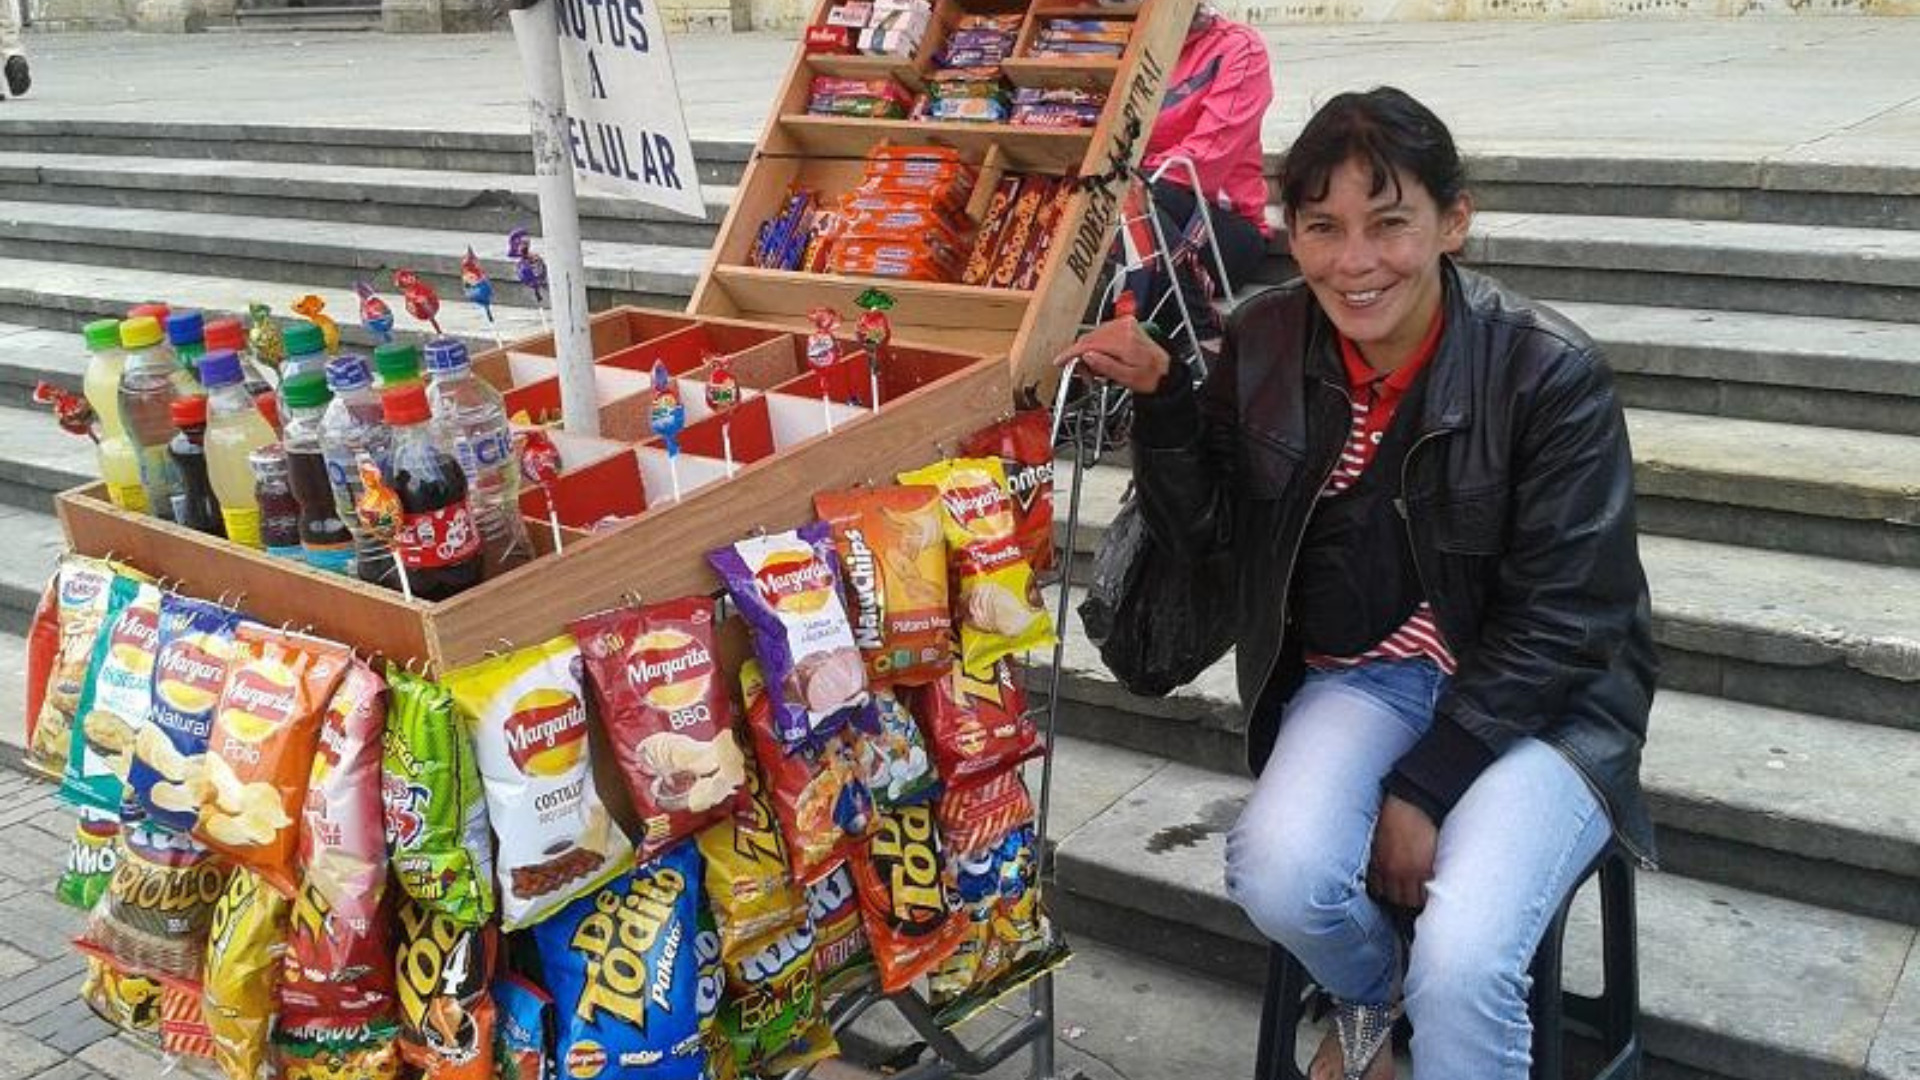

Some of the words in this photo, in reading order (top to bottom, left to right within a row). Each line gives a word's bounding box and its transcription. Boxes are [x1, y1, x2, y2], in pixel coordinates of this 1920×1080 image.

[588, 48, 607, 99] A
[628, 648, 712, 683] Margarita
[150, 704, 210, 737] Natural
[669, 704, 711, 731] BBQ
[571, 889, 620, 955] De
[577, 867, 686, 1029] Todito
